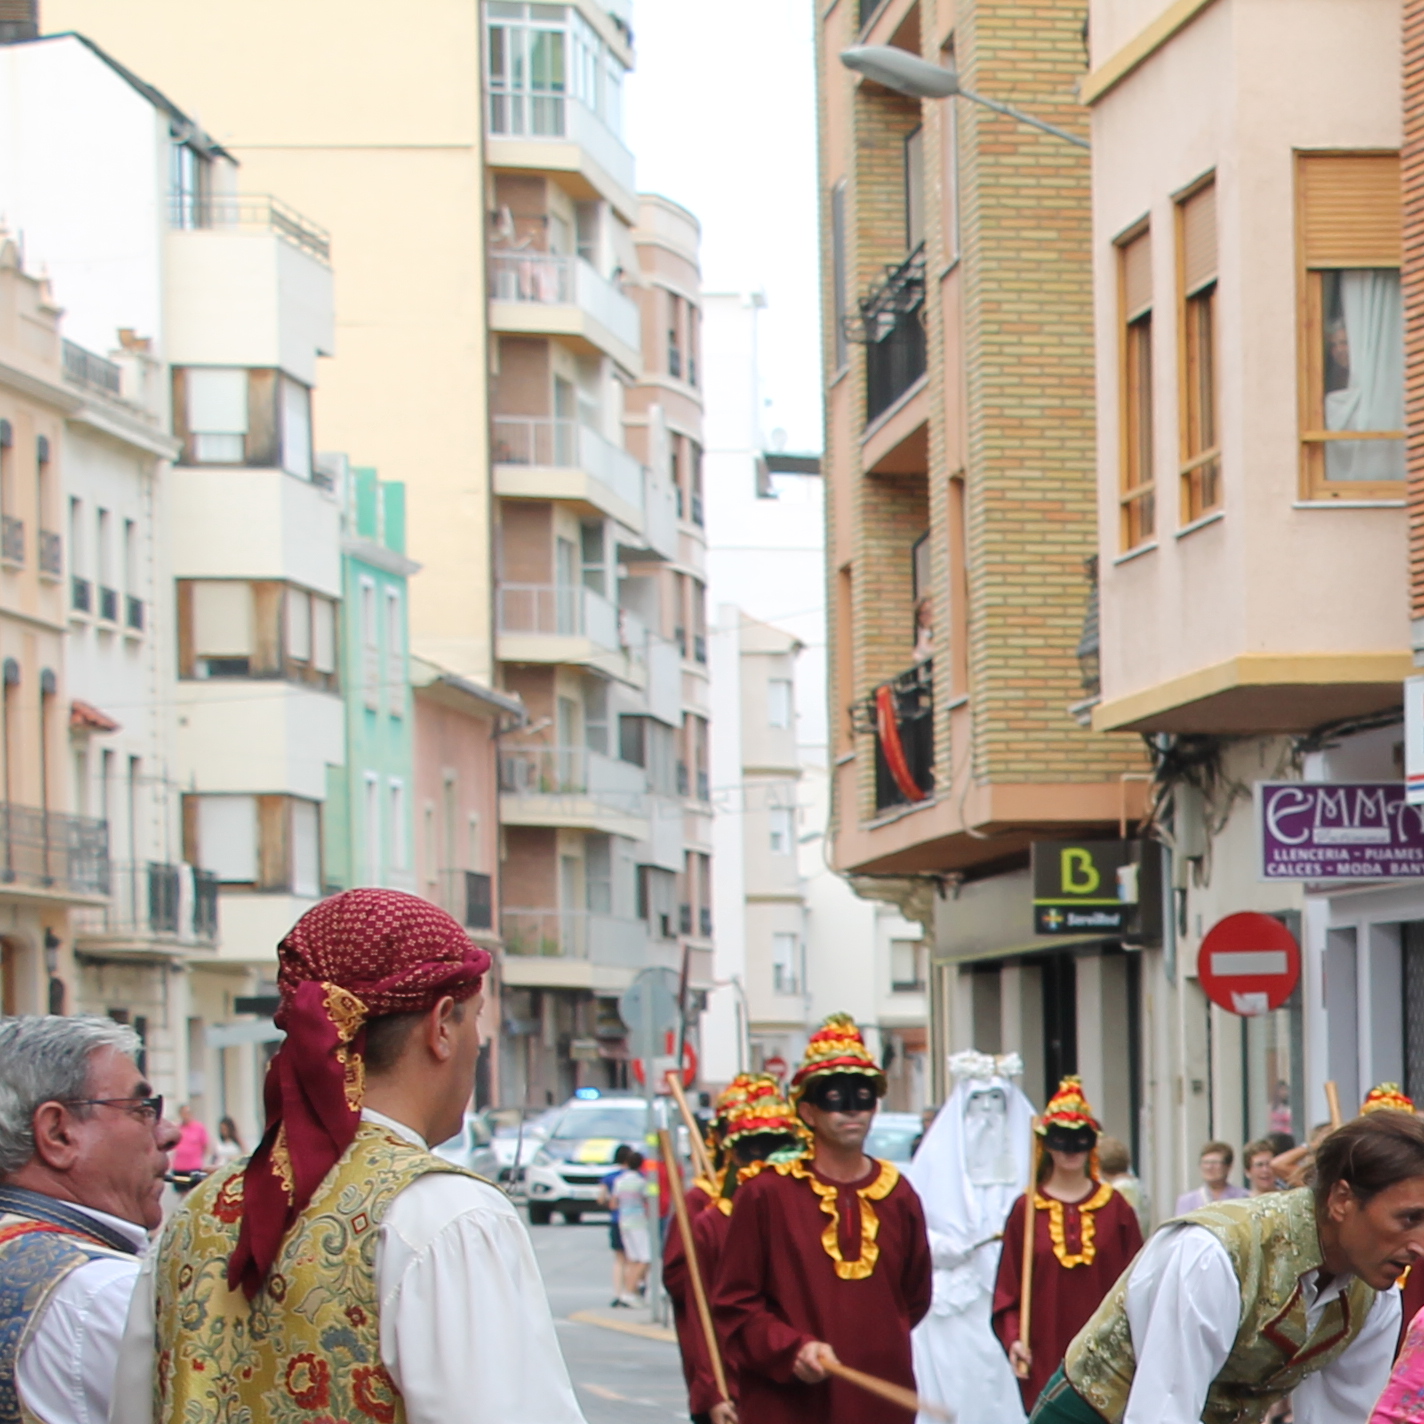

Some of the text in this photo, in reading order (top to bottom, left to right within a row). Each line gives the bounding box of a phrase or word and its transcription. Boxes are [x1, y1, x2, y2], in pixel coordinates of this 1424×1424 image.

[1273, 848, 1350, 861] LLENCERIA
[1061, 846, 1100, 894] B
[1267, 862, 1323, 875] CALCES
[1336, 862, 1383, 875] MODA
